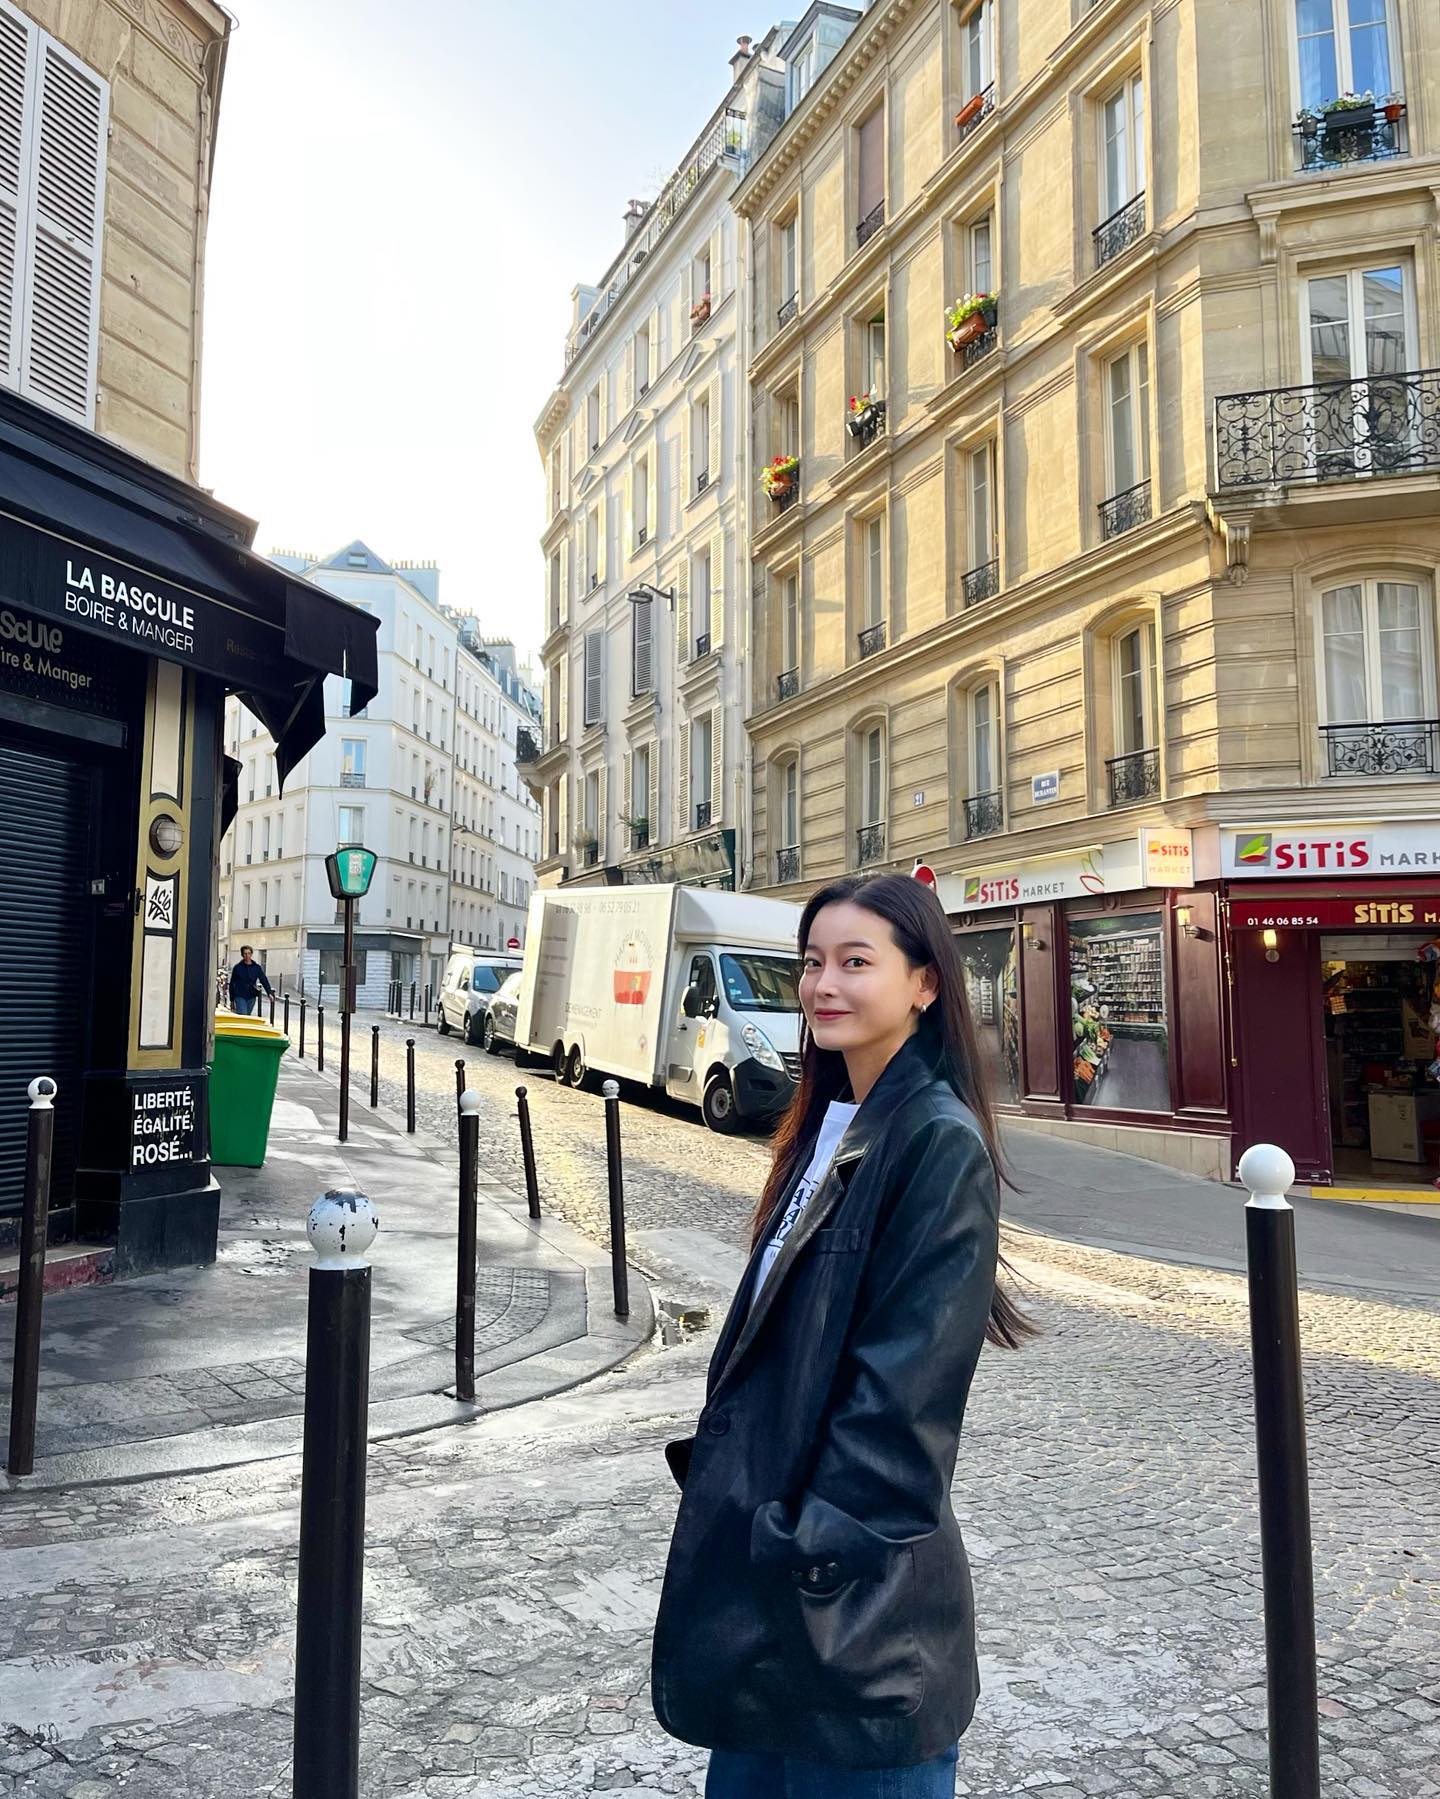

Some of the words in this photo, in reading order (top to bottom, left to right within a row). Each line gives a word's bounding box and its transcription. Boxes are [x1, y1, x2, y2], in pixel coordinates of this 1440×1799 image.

[66, 560, 95, 594] LA
[101, 574, 194, 630] BASCULE
[66, 591, 114, 626] BOIRE
[118, 611, 129, 631] &
[132, 616, 194, 653] MANGER
[22, 652, 34, 672] &
[37, 657, 93, 689] Manger
[1161, 845, 1189, 857] SiTiS
[1275, 841, 1369, 870] SiTiS
[980, 878, 1020, 904] SiTiS
[1023, 882, 1065, 898] MARKET
[1247, 918, 1259, 926] 01
[1262, 917, 1275, 926] 46
[1276, 917, 1290, 926] 06
[1291, 917, 1304, 925] 85
[1306, 916, 1319, 925] 54
[1354, 903, 1414, 923] SiTiS
[134, 1085, 194, 1111] LIBERTÉ,
[133, 1109, 194, 1136] ÉGALITÉ,
